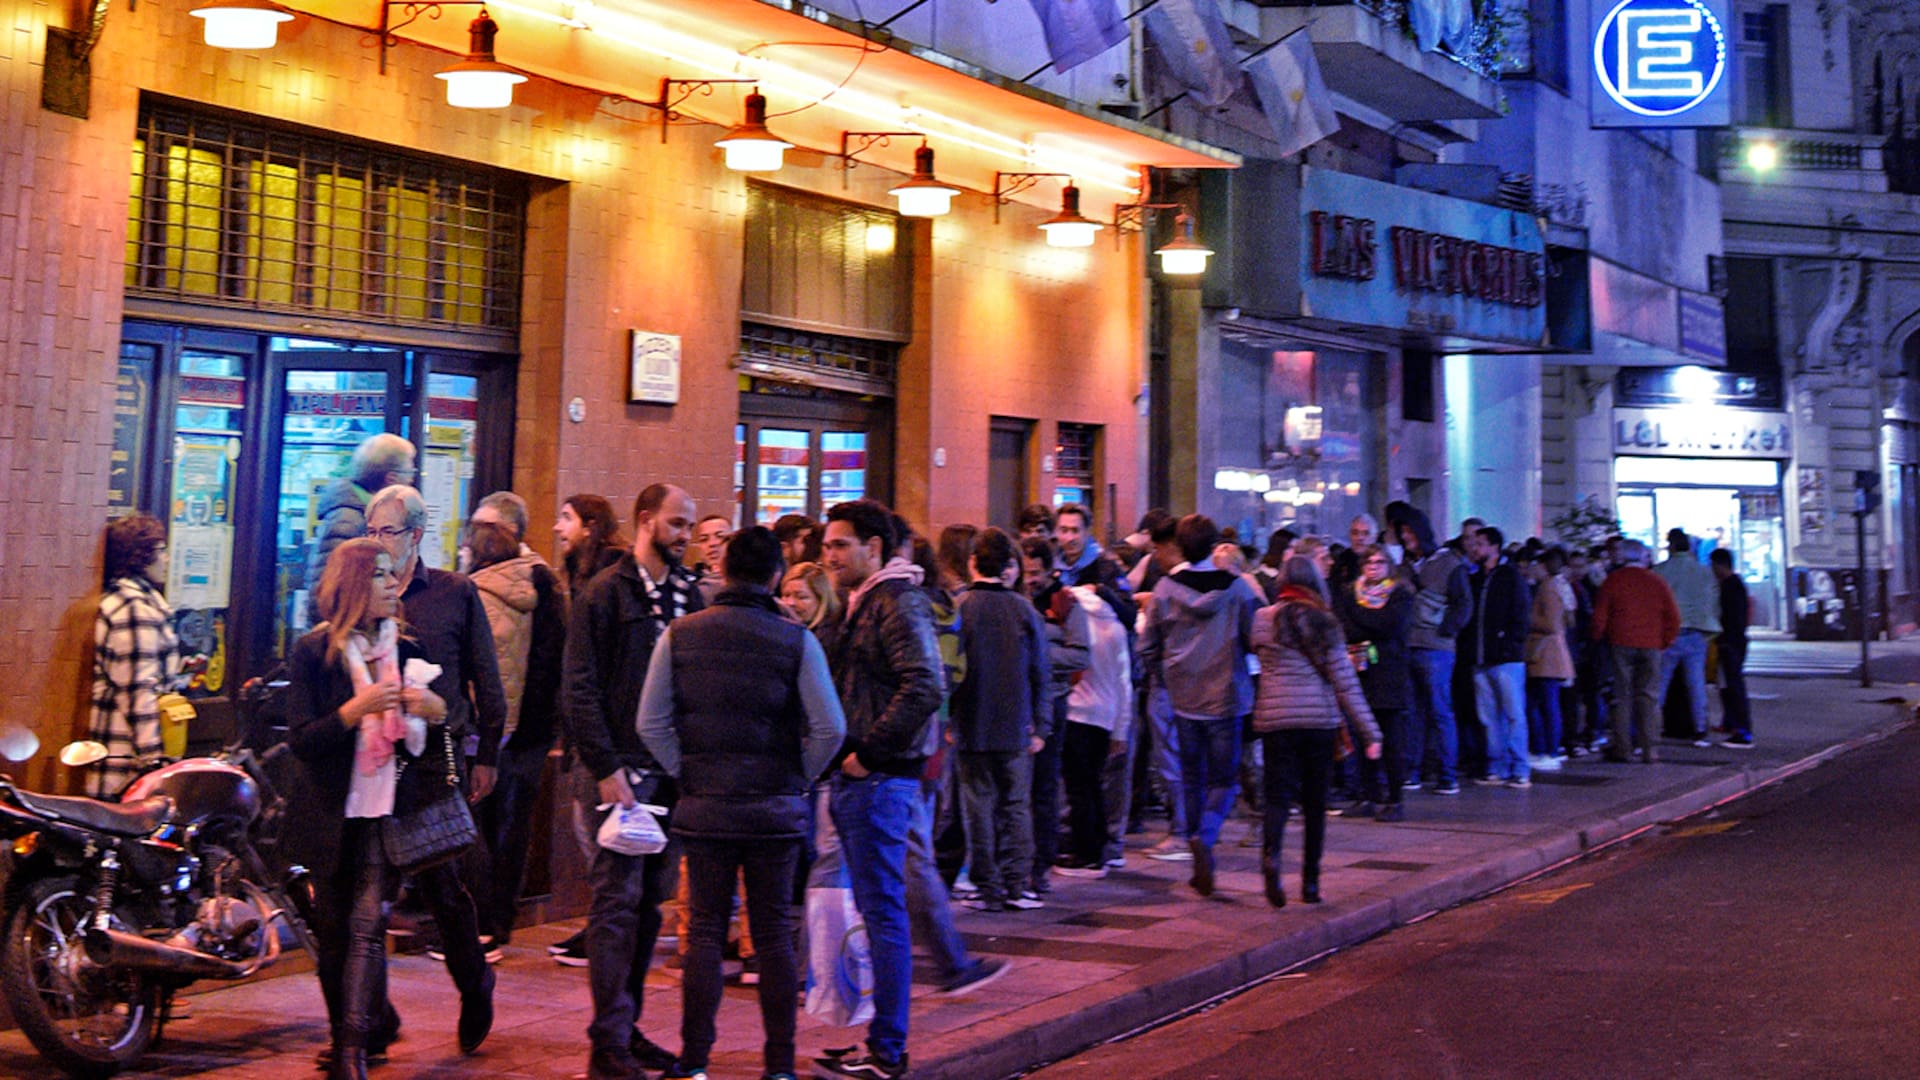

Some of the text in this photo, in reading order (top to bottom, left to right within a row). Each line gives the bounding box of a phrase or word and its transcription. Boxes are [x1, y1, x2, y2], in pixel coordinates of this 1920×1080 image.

[1617, 9, 1703, 96] E
[1309, 210, 1545, 308] LAS VICTORIAS
[1616, 419, 1790, 451] L&L ket
